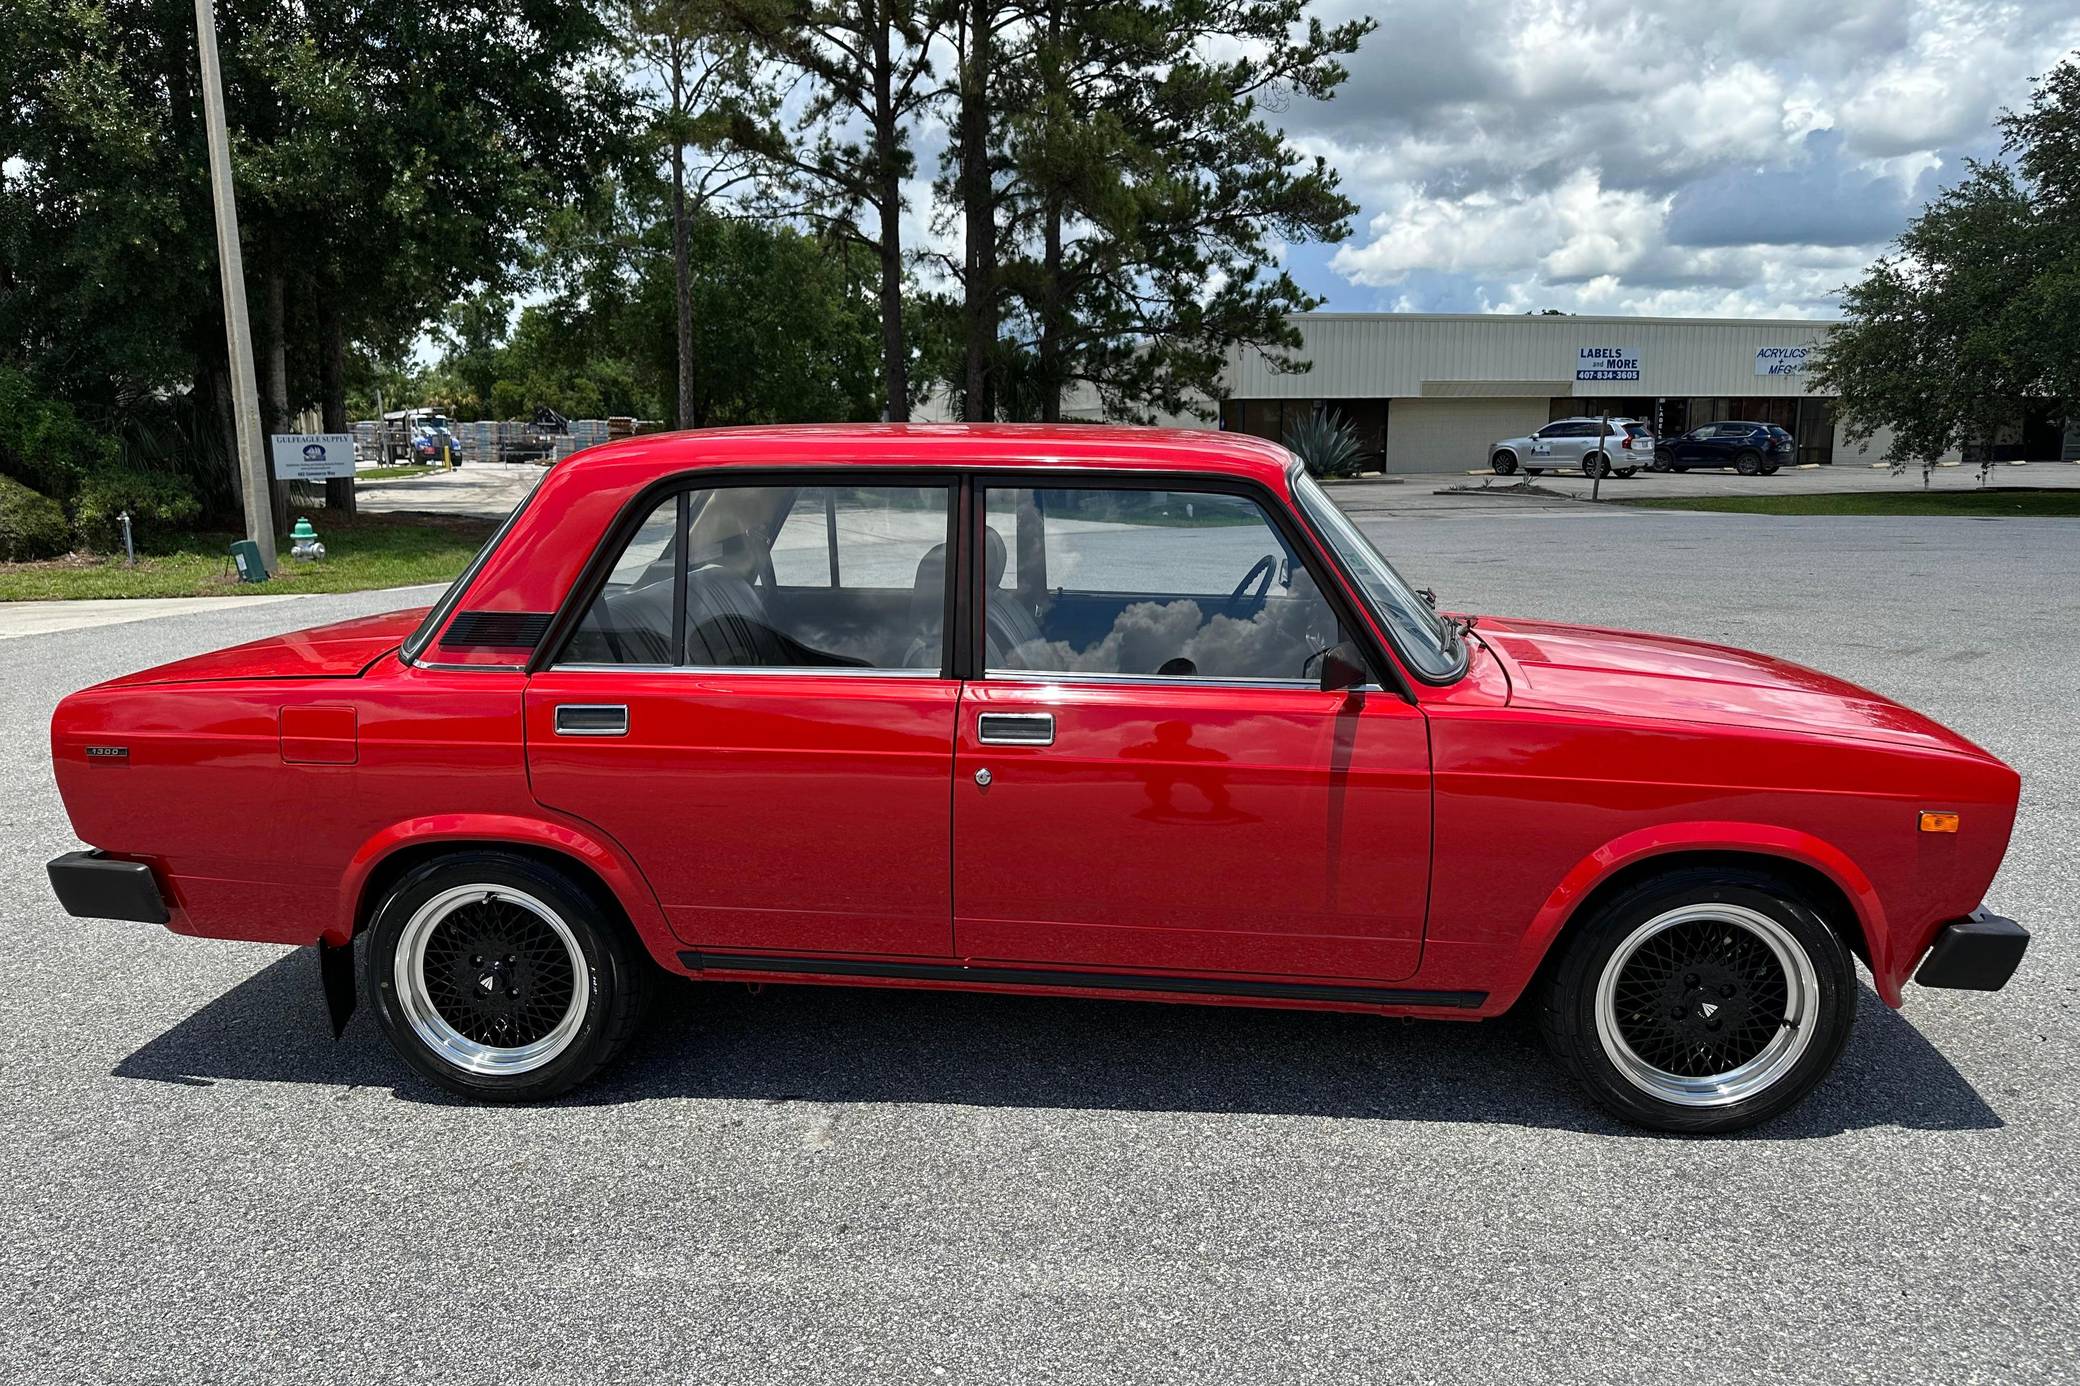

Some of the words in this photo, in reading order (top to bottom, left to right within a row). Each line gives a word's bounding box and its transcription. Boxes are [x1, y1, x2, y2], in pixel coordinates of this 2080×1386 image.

[1580, 348, 1622, 358] LABELS
[1756, 348, 1808, 358] ACRYLICS
[1606, 360, 1638, 369] MORE
[1578, 371, 1638, 379] 407-834-3605
[322, 435, 348, 443] SUPPLY
